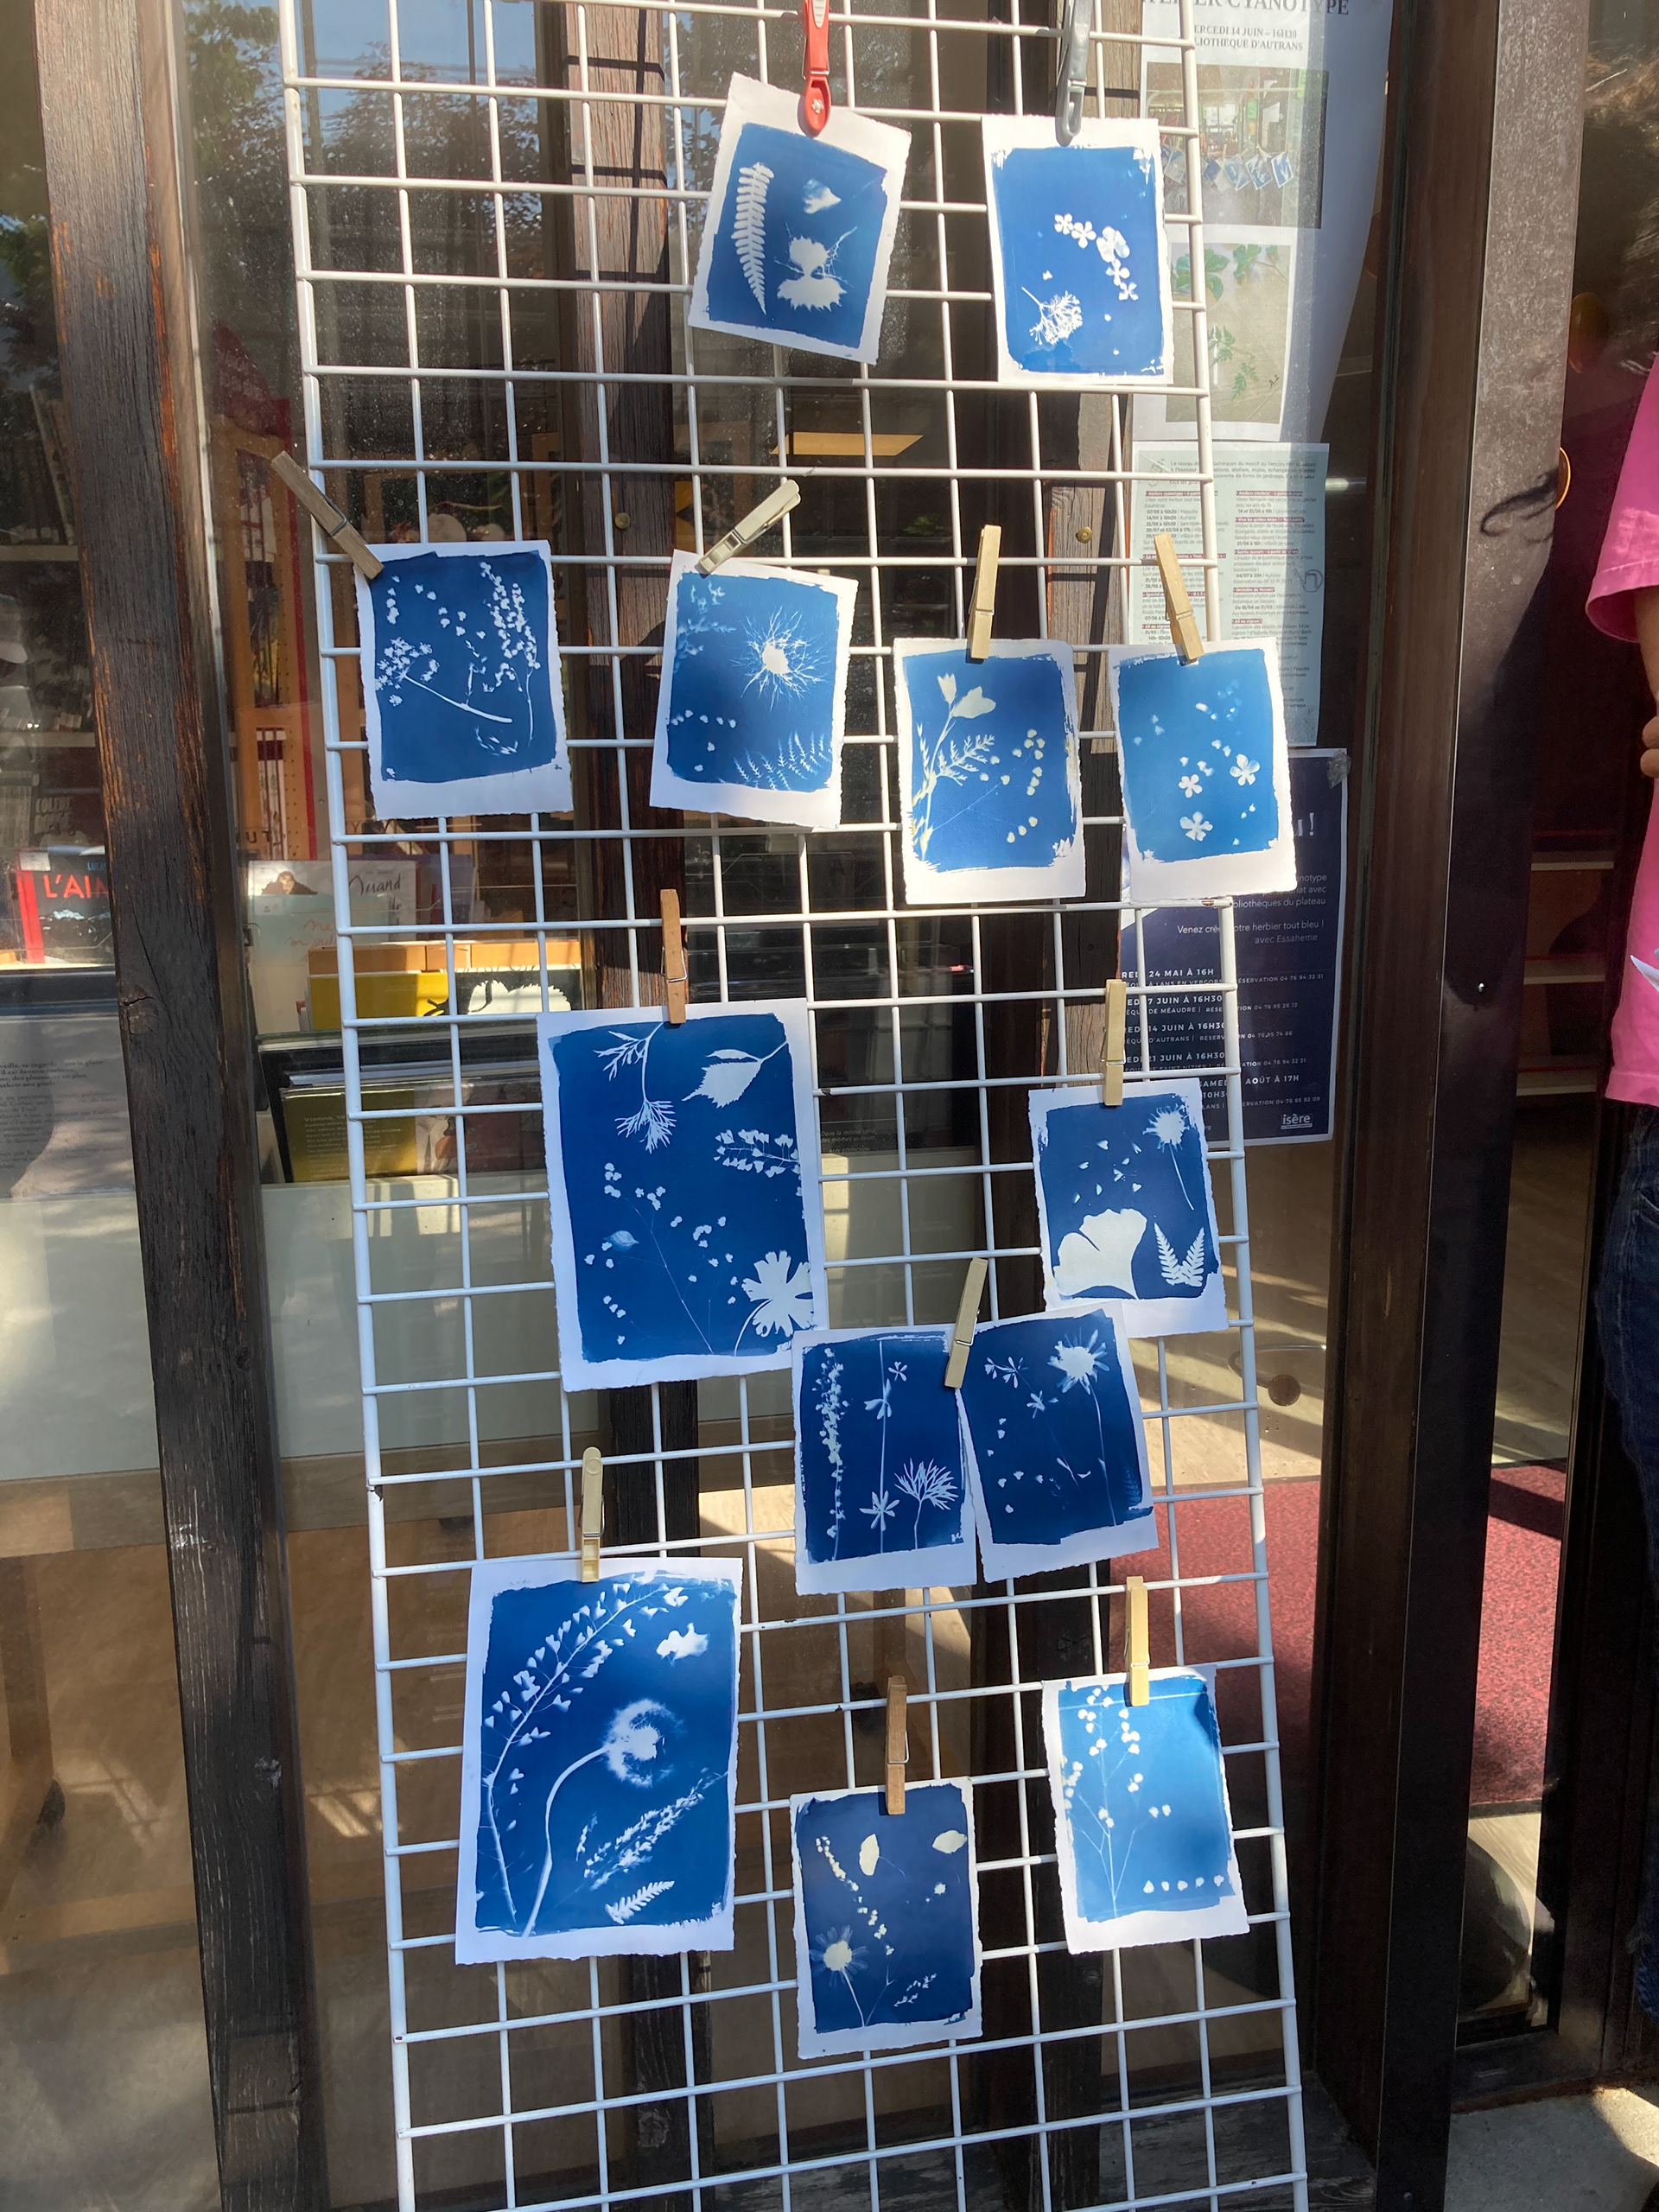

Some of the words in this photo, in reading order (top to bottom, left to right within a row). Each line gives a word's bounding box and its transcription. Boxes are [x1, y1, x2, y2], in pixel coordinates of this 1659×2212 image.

[1194, 25, 1229, 35] ERCEDI
[1231, 26, 1240, 35] 14
[1243, 28, 1263, 36] JUIN
[1273, 29, 1297, 38] 16H30
[1194, 37, 1249, 48] LIOTHEQUE
[1251, 40, 1303, 50] D'AUTRANS
[1233, 898, 1281, 909] bliothèques
[1284, 897, 1294, 906] du
[1296, 897, 1326, 906] plateau
[1177, 925, 1203, 934] Venez
[1205, 924, 1220, 933] cré
[1233, 924, 1250, 932] otre
[1252, 922, 1281, 931] herbier
[1283, 921, 1300, 930] tout
[1301, 919, 1319, 929] bleu
[1186, 967, 1193, 976] À
[1156, 996, 1179, 1005] JUIN
[1193, 995, 1223, 1003] 16H30
[1188, 1021, 1194, 1030] À
[1160, 1053, 1183, 1062] JUIN
[1245, 1075, 1271, 1085] AOÛT
[1274, 1074, 1280, 1083] À
[1202, 1090, 1225, 1099] 10H3
[1282, 1113, 1311, 1125] isère
